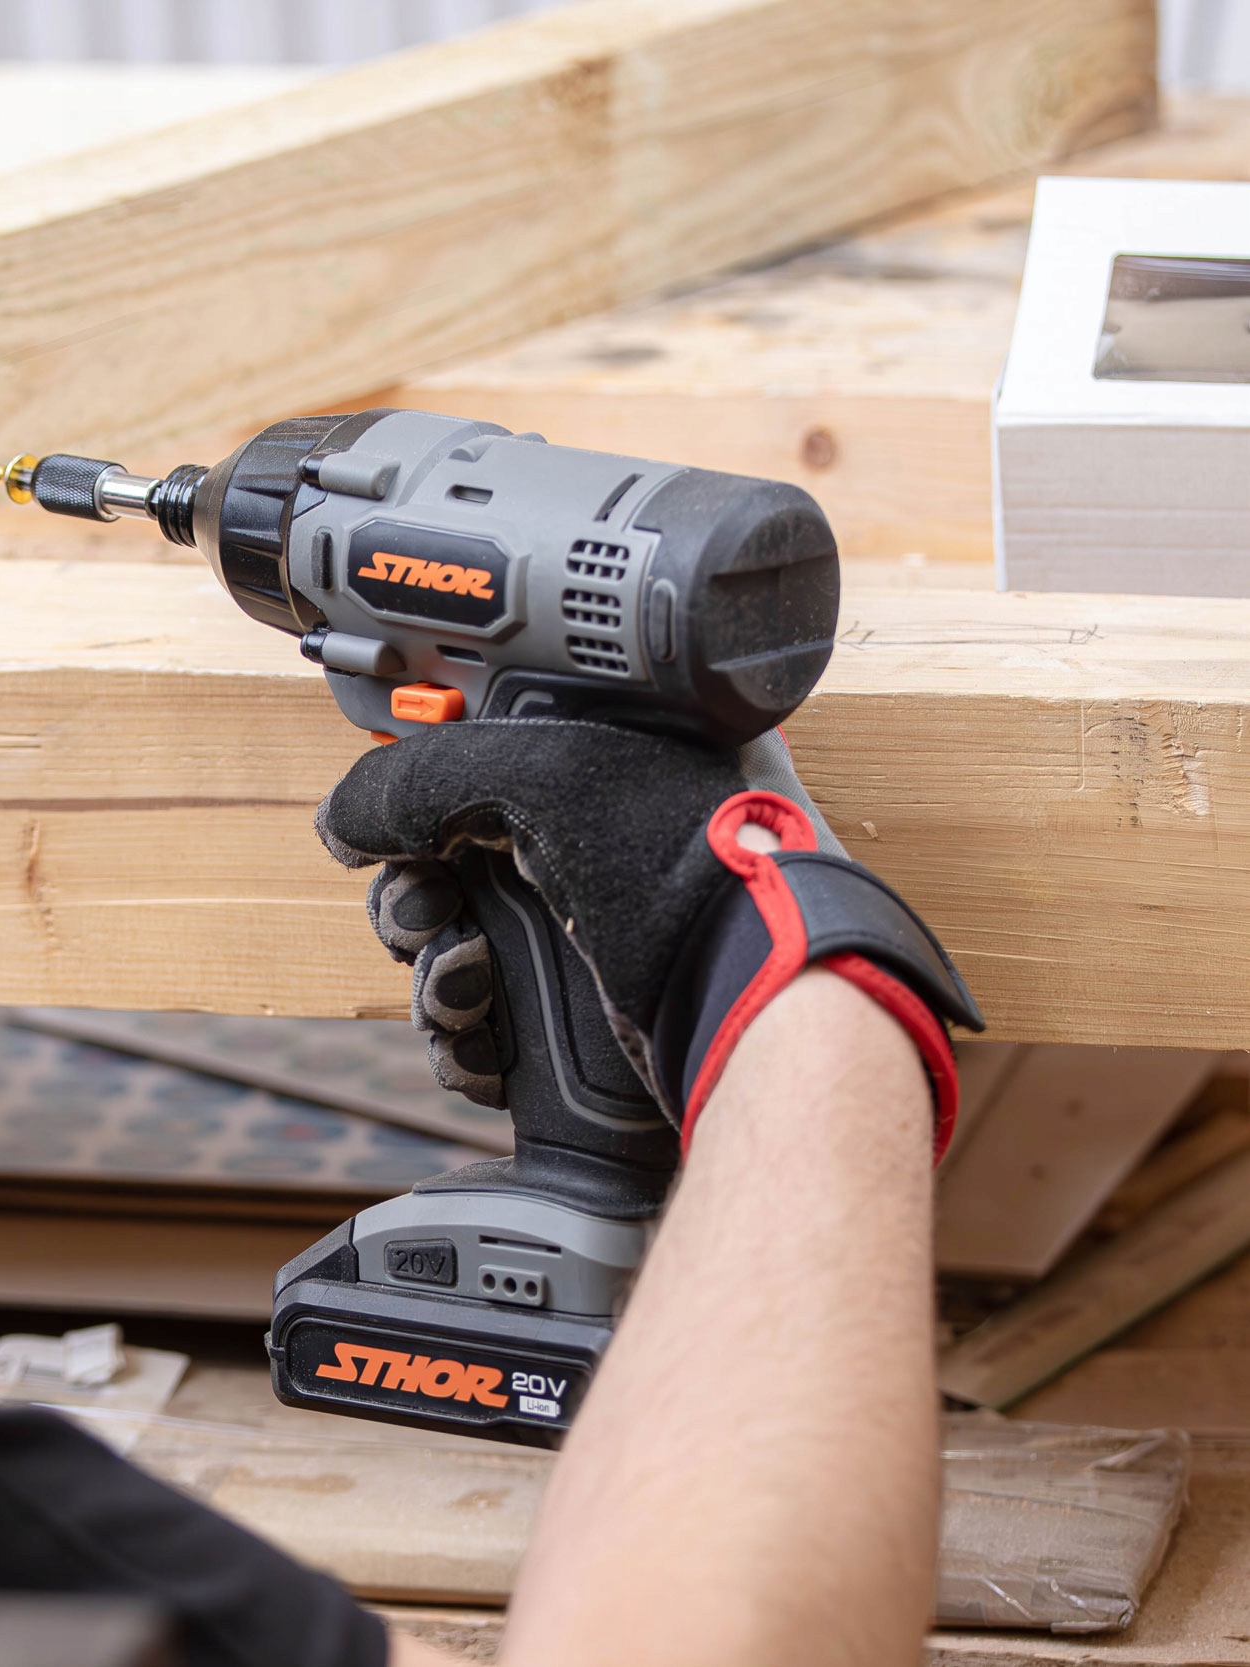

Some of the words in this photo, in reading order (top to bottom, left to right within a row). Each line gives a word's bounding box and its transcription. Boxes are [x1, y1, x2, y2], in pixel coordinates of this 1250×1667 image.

[357, 551, 495, 600] STHOR
[395, 1250, 446, 1276] 20V
[315, 1341, 510, 1409] STHOR
[512, 1371, 567, 1398] 20V
